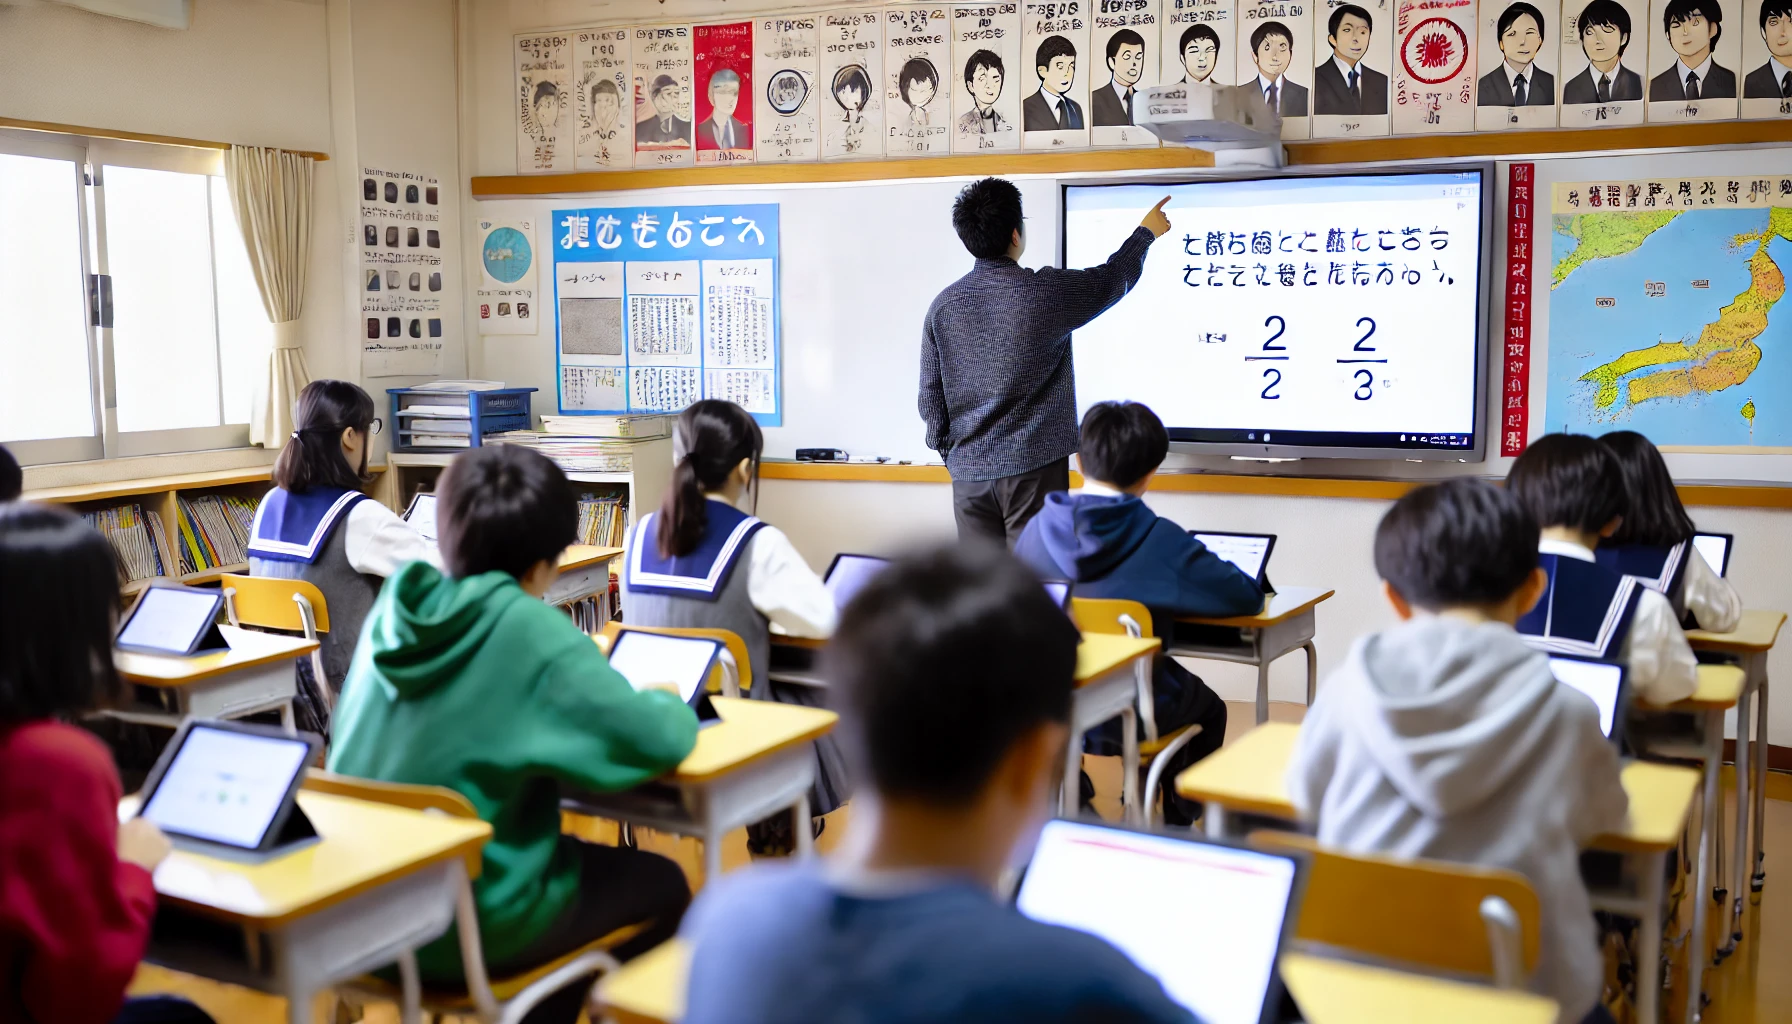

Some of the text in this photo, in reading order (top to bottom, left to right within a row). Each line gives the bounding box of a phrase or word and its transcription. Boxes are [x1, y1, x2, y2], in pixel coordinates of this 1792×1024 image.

[1262, 315, 1287, 351] 2
[1353, 316, 1377, 352] 2
[1260, 368, 1282, 400] 2
